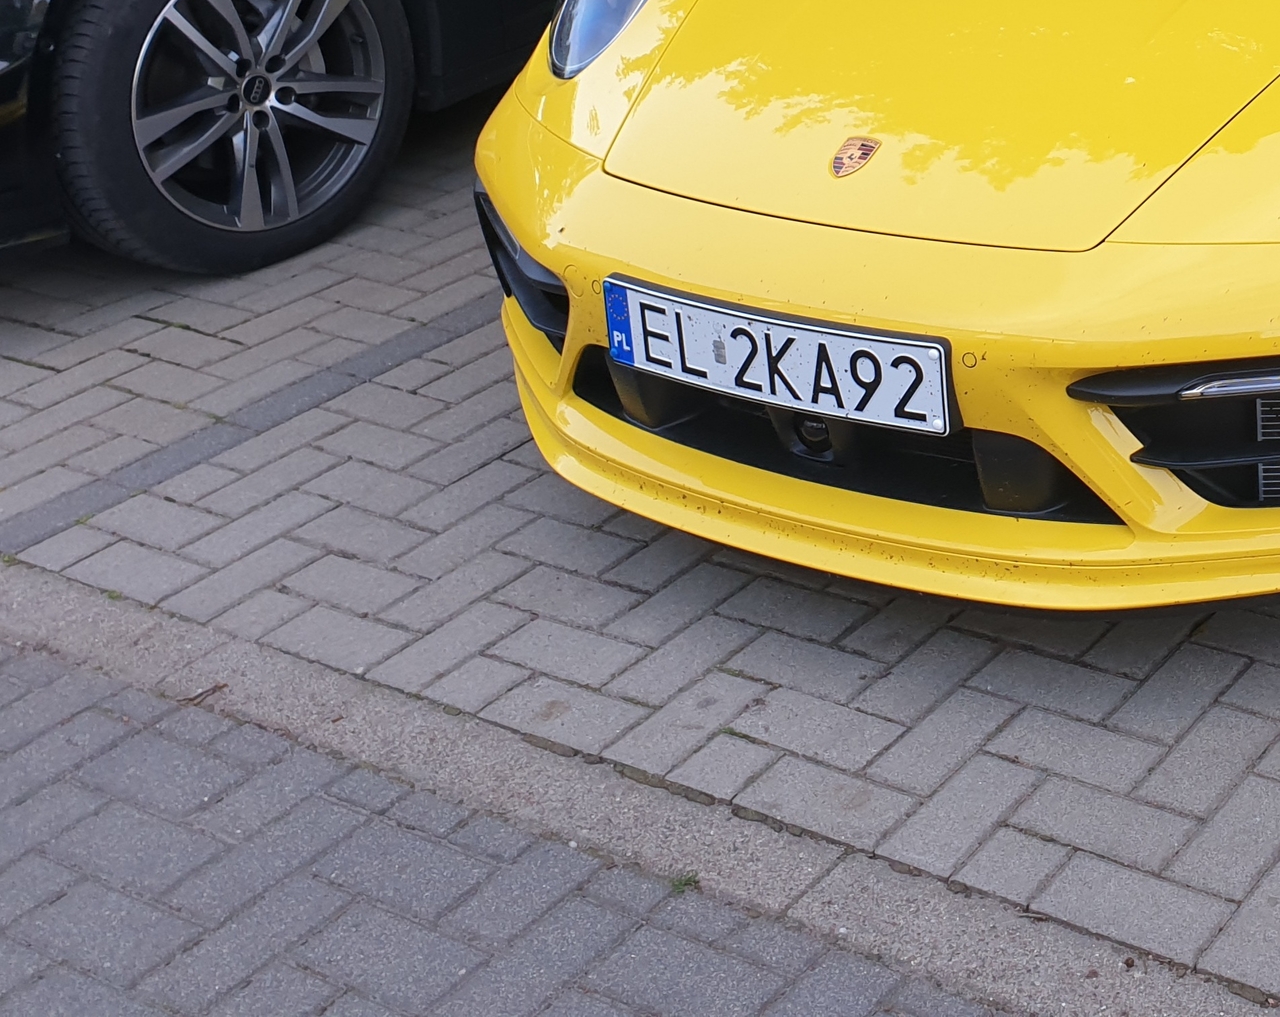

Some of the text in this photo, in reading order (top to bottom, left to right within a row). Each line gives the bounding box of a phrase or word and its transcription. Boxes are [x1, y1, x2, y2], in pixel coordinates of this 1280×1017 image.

[613, 330, 631, 351] PL
[639, 301, 927, 422] EL 2KA92
